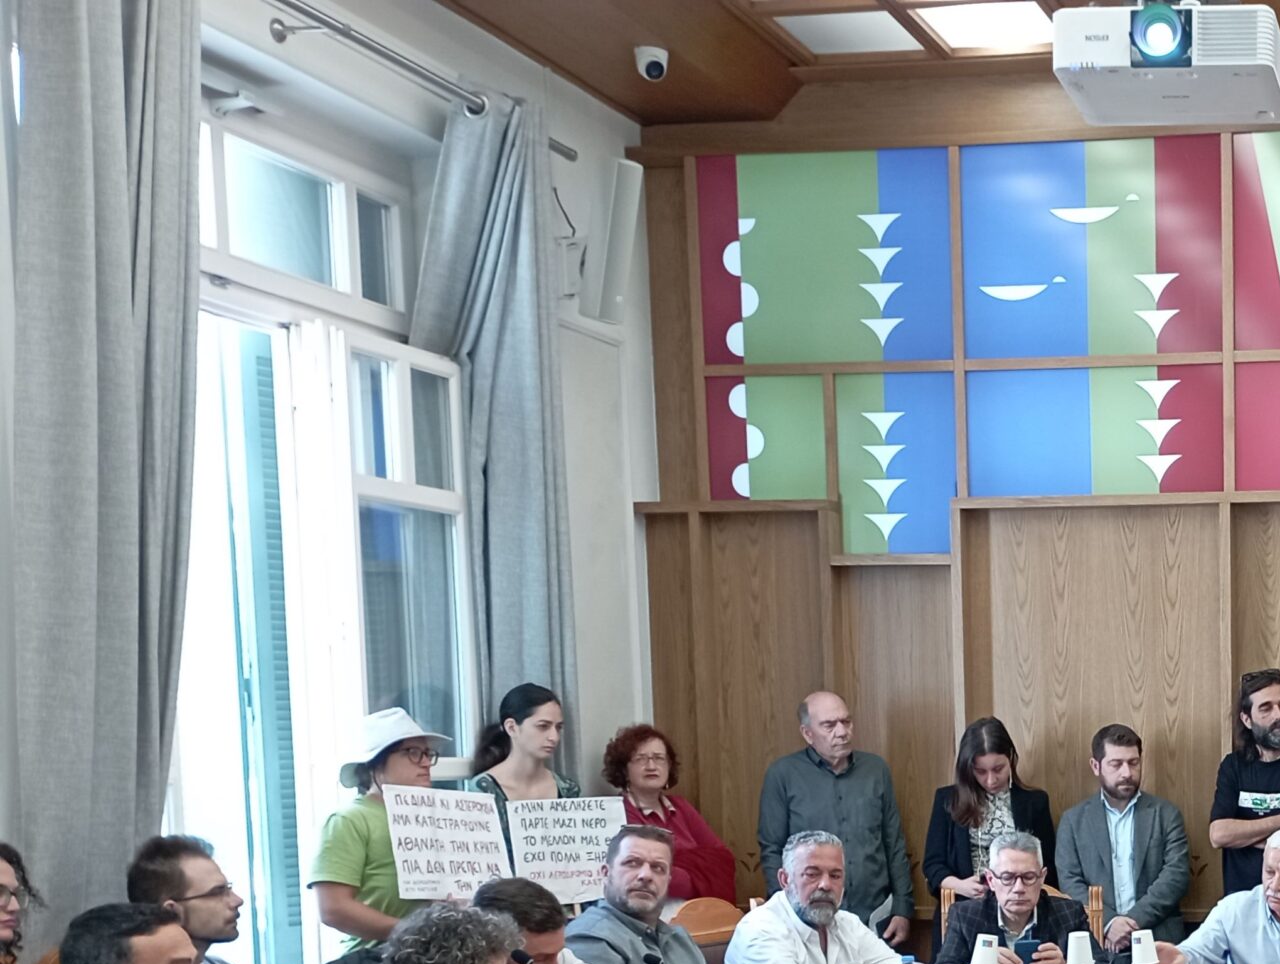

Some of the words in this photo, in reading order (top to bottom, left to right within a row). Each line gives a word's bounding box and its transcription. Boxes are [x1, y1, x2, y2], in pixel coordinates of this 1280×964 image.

[550, 799, 606, 812] ΑΜΕΛΗΣΕΤΕ
[520, 817, 549, 831] ΠΑΡΤΕ
[553, 818, 577, 829] ΜΑΖΙ
[581, 818, 607, 829] ΝΕΡΟ
[449, 840, 470, 854] ΤΗΝ
[522, 835, 536, 846] ΤΟ
[541, 835, 576, 847] ΜΕΛΛΟΝ
[581, 835, 600, 847] ΜΑΣ
[523, 851, 545, 863] ΕΧΕΙ
[550, 851, 580, 864] ΠΟΛΛΗ
[586, 851, 607, 863] ΞΗΡ
[402, 859, 424, 875] ΠΙΑ
[426, 859, 446, 874] ΔΕΝ
[449, 860, 482, 876] ΠΡΕΠΕΙ
[486, 861, 501, 874] ΝΑ
[529, 872, 545, 880] ΟΧΙ
[581, 878, 603, 887] ΚΑΣΤ
[454, 880, 472, 892] ΤΗΝ
